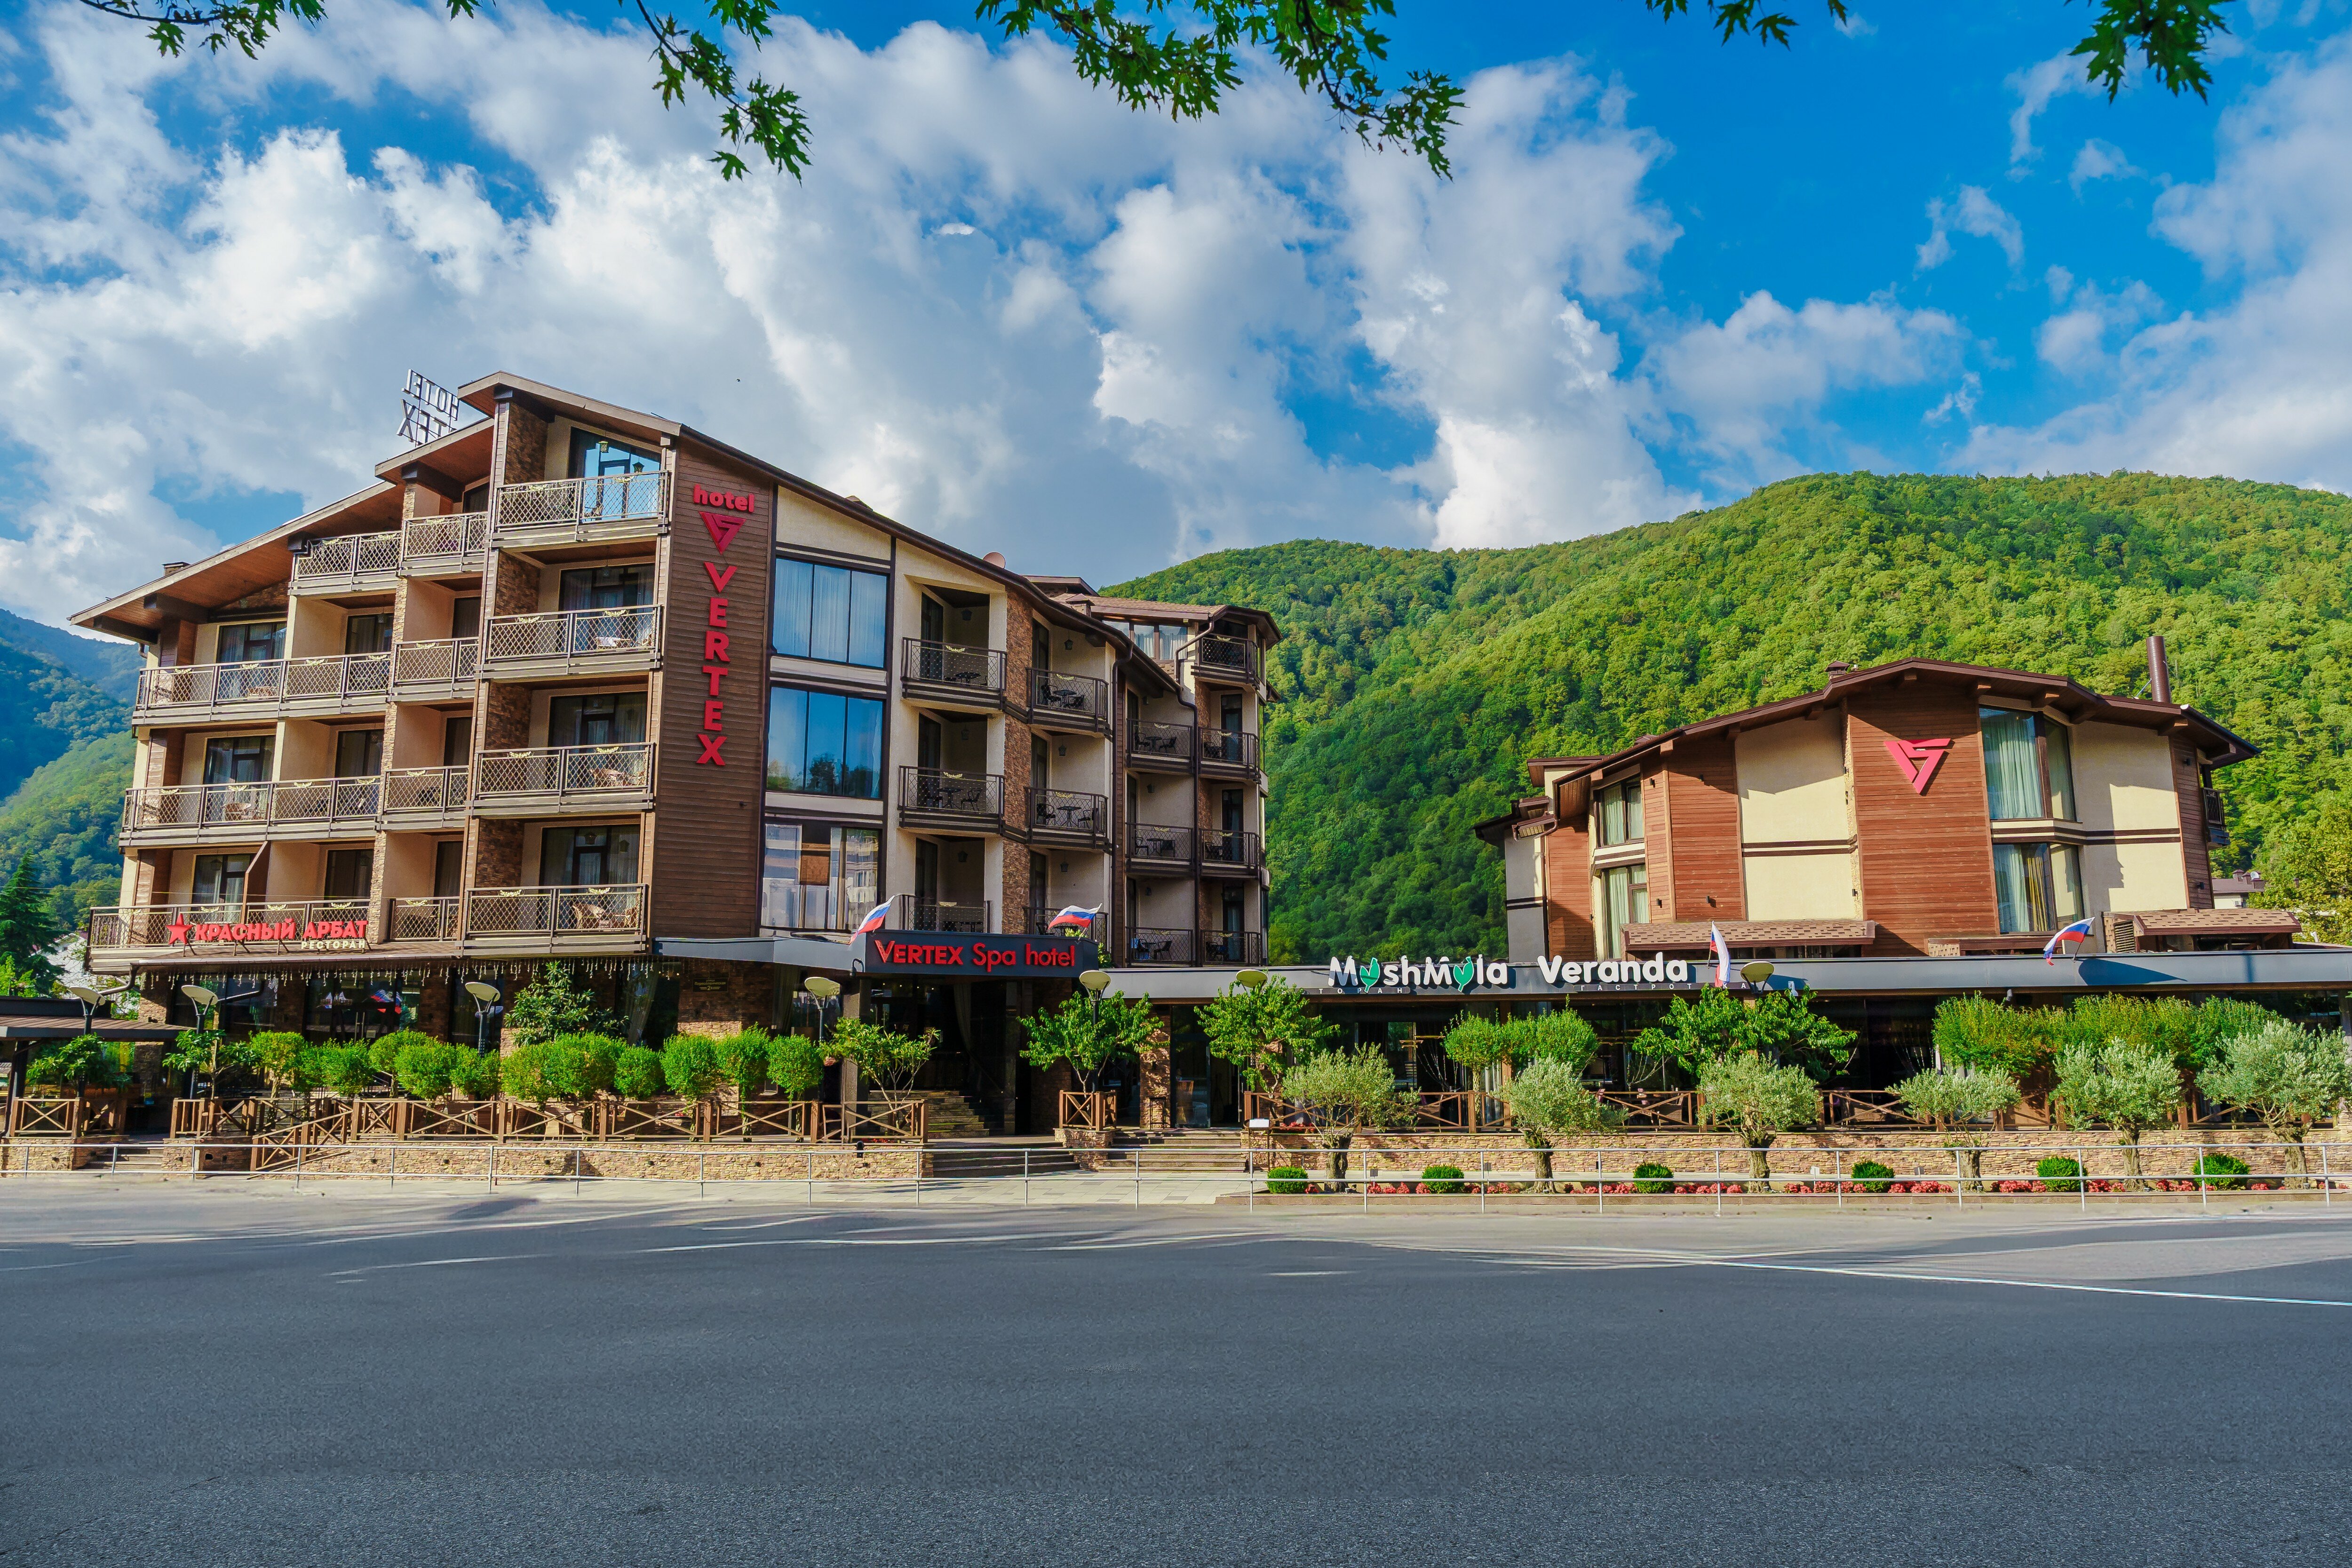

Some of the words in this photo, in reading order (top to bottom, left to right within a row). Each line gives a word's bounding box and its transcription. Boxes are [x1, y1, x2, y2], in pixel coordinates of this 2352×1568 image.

[693, 484, 755, 513] hotel
[696, 561, 738, 766] VERTEX
[195, 918, 296, 940] КРАСНЫЙ
[302, 920, 368, 939] АРБАТ
[301, 940, 366, 949] РЕСТОРАН
[874, 940, 963, 965] VERTEX
[973, 943, 1016, 972] Spa
[1025, 943, 1075, 967] hotel
[1537, 952, 1688, 984] Veranda
[1581, 982, 1747, 991] ГАСТРОТКА
